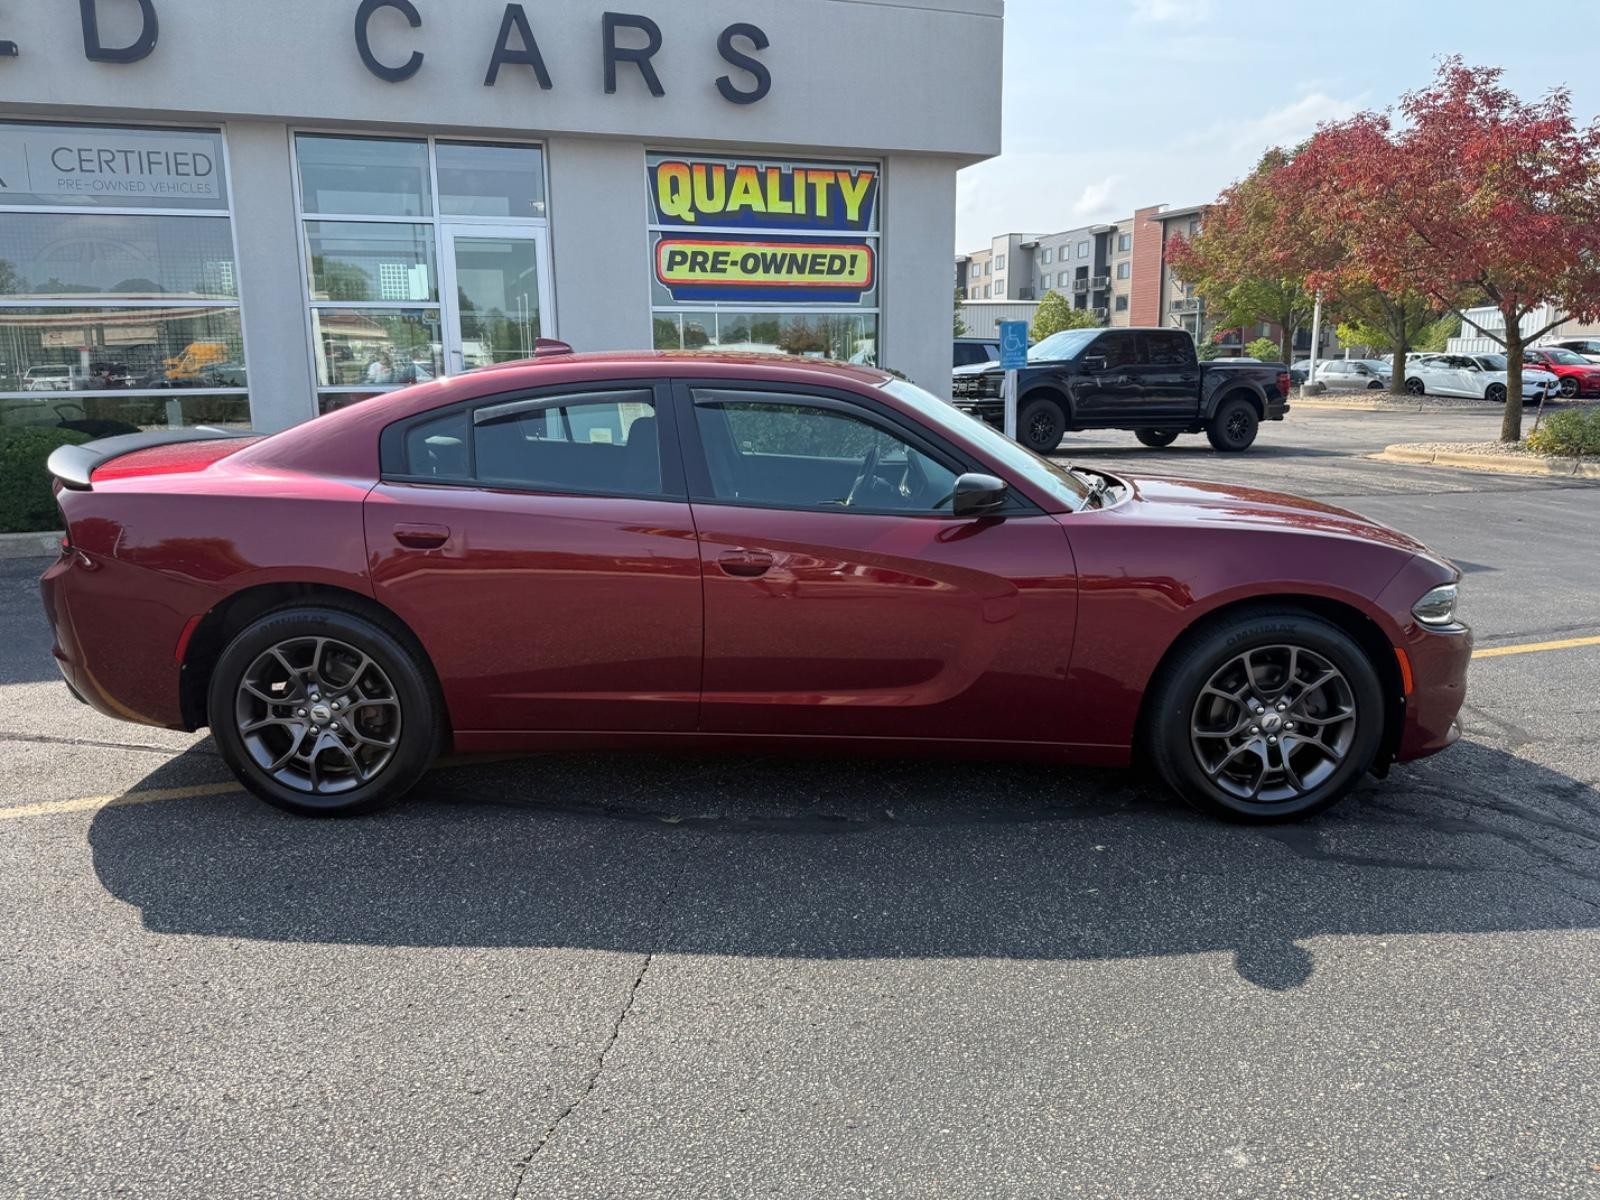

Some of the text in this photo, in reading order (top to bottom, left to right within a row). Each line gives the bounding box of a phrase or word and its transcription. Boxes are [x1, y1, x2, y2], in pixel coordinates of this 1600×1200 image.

[0, 0, 772, 104] D CARS
[51, 147, 213, 177] CERTIFIED
[57, 178, 212, 194] PRE-OWNED VEHICLES
[656, 161, 876, 222] QUALITY
[666, 249, 859, 276] PRE-OWNED!
